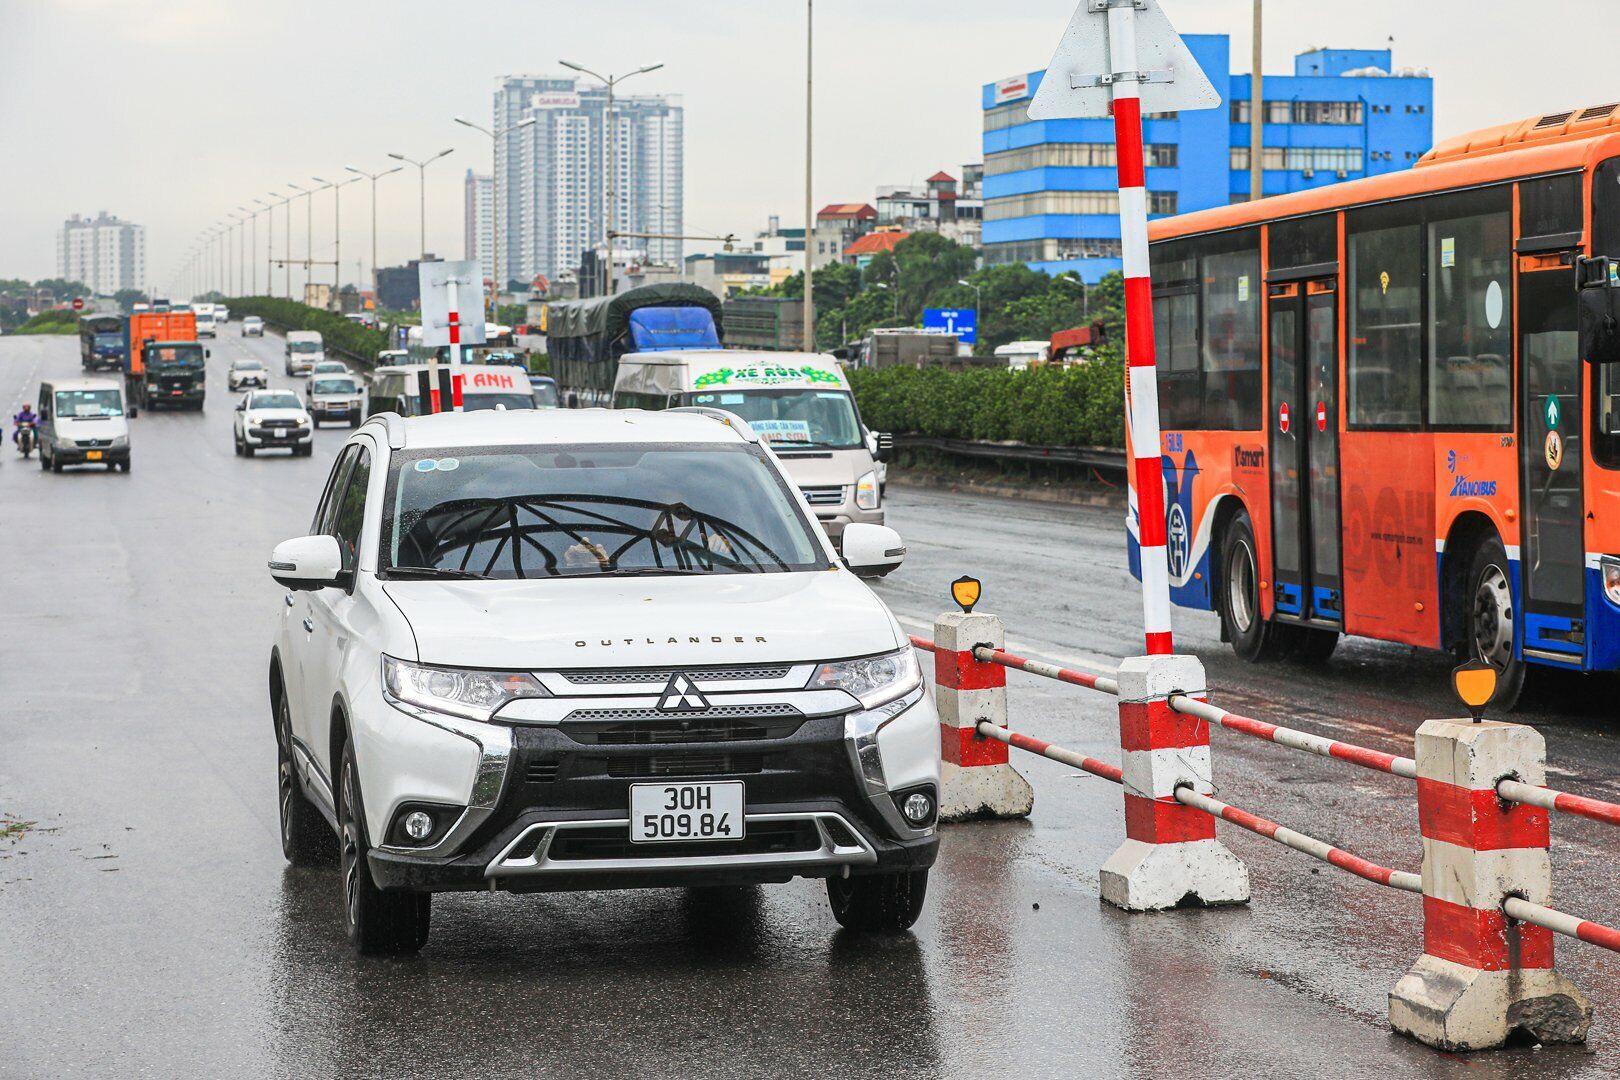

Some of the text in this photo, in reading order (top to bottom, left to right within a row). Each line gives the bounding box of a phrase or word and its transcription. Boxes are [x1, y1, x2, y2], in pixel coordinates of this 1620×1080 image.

[473, 373, 513, 388] ANH
[735, 368, 759, 378] XE
[574, 636, 767, 648] OUTLANDER
[664, 786, 712, 811] 30H
[643, 812, 732, 838] 509.84
